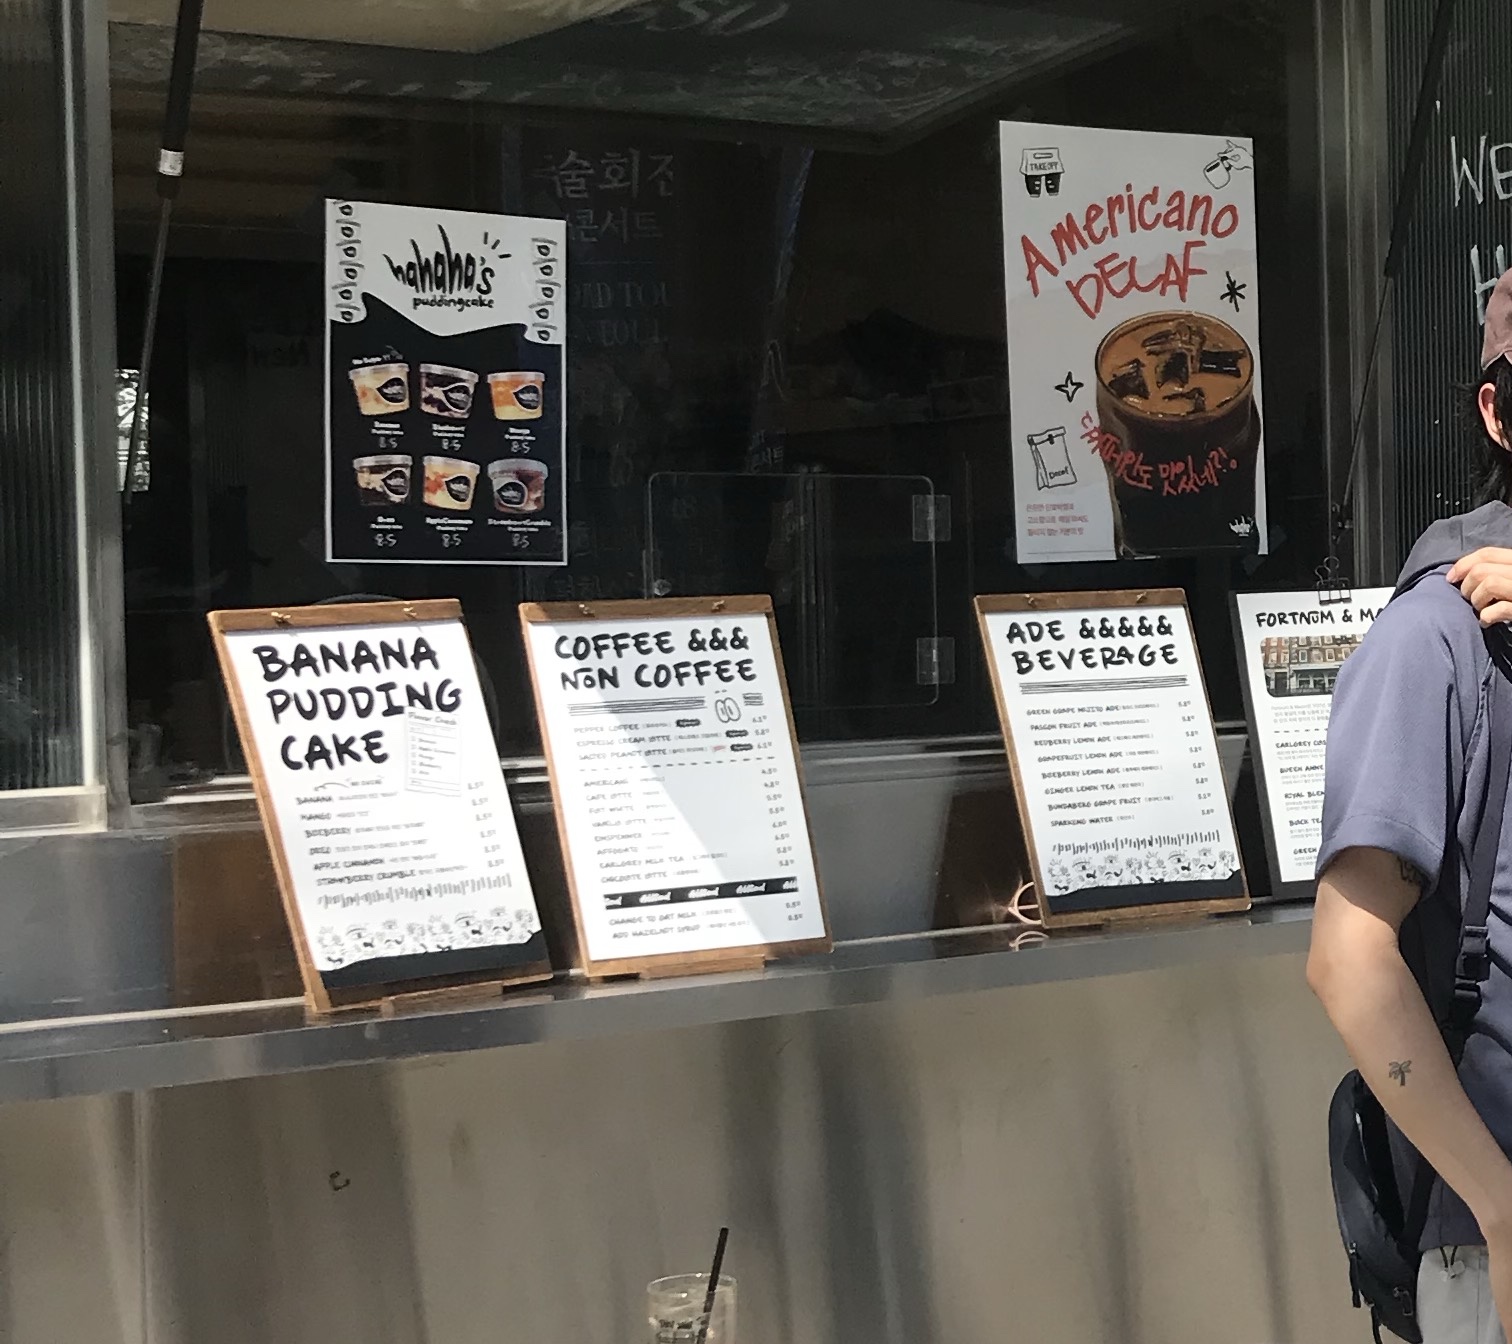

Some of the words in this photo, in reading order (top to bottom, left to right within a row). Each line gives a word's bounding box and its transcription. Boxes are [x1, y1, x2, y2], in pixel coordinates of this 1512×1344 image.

[1021, 183, 1239, 298] Americano
[1065, 241, 1208, 319] DECAF
[412, 294, 495, 313] puddingcake
[1006, 619, 1065, 644] ADE
[1079, 614, 1174, 640] &&&&&
[1255, 609, 1335, 628] FORTNUM
[1341, 608, 1353, 623] &
[253, 636, 440, 682] BANANA
[554, 631, 676, 661] COFFEE
[688, 626, 749, 652] &&&
[1011, 643, 1179, 675] BEVERAGE
[561, 665, 620, 691] NON
[634, 659, 757, 688] COFFEE
[266, 678, 462, 725] PUDDING
[281, 729, 389, 771] CAKE
